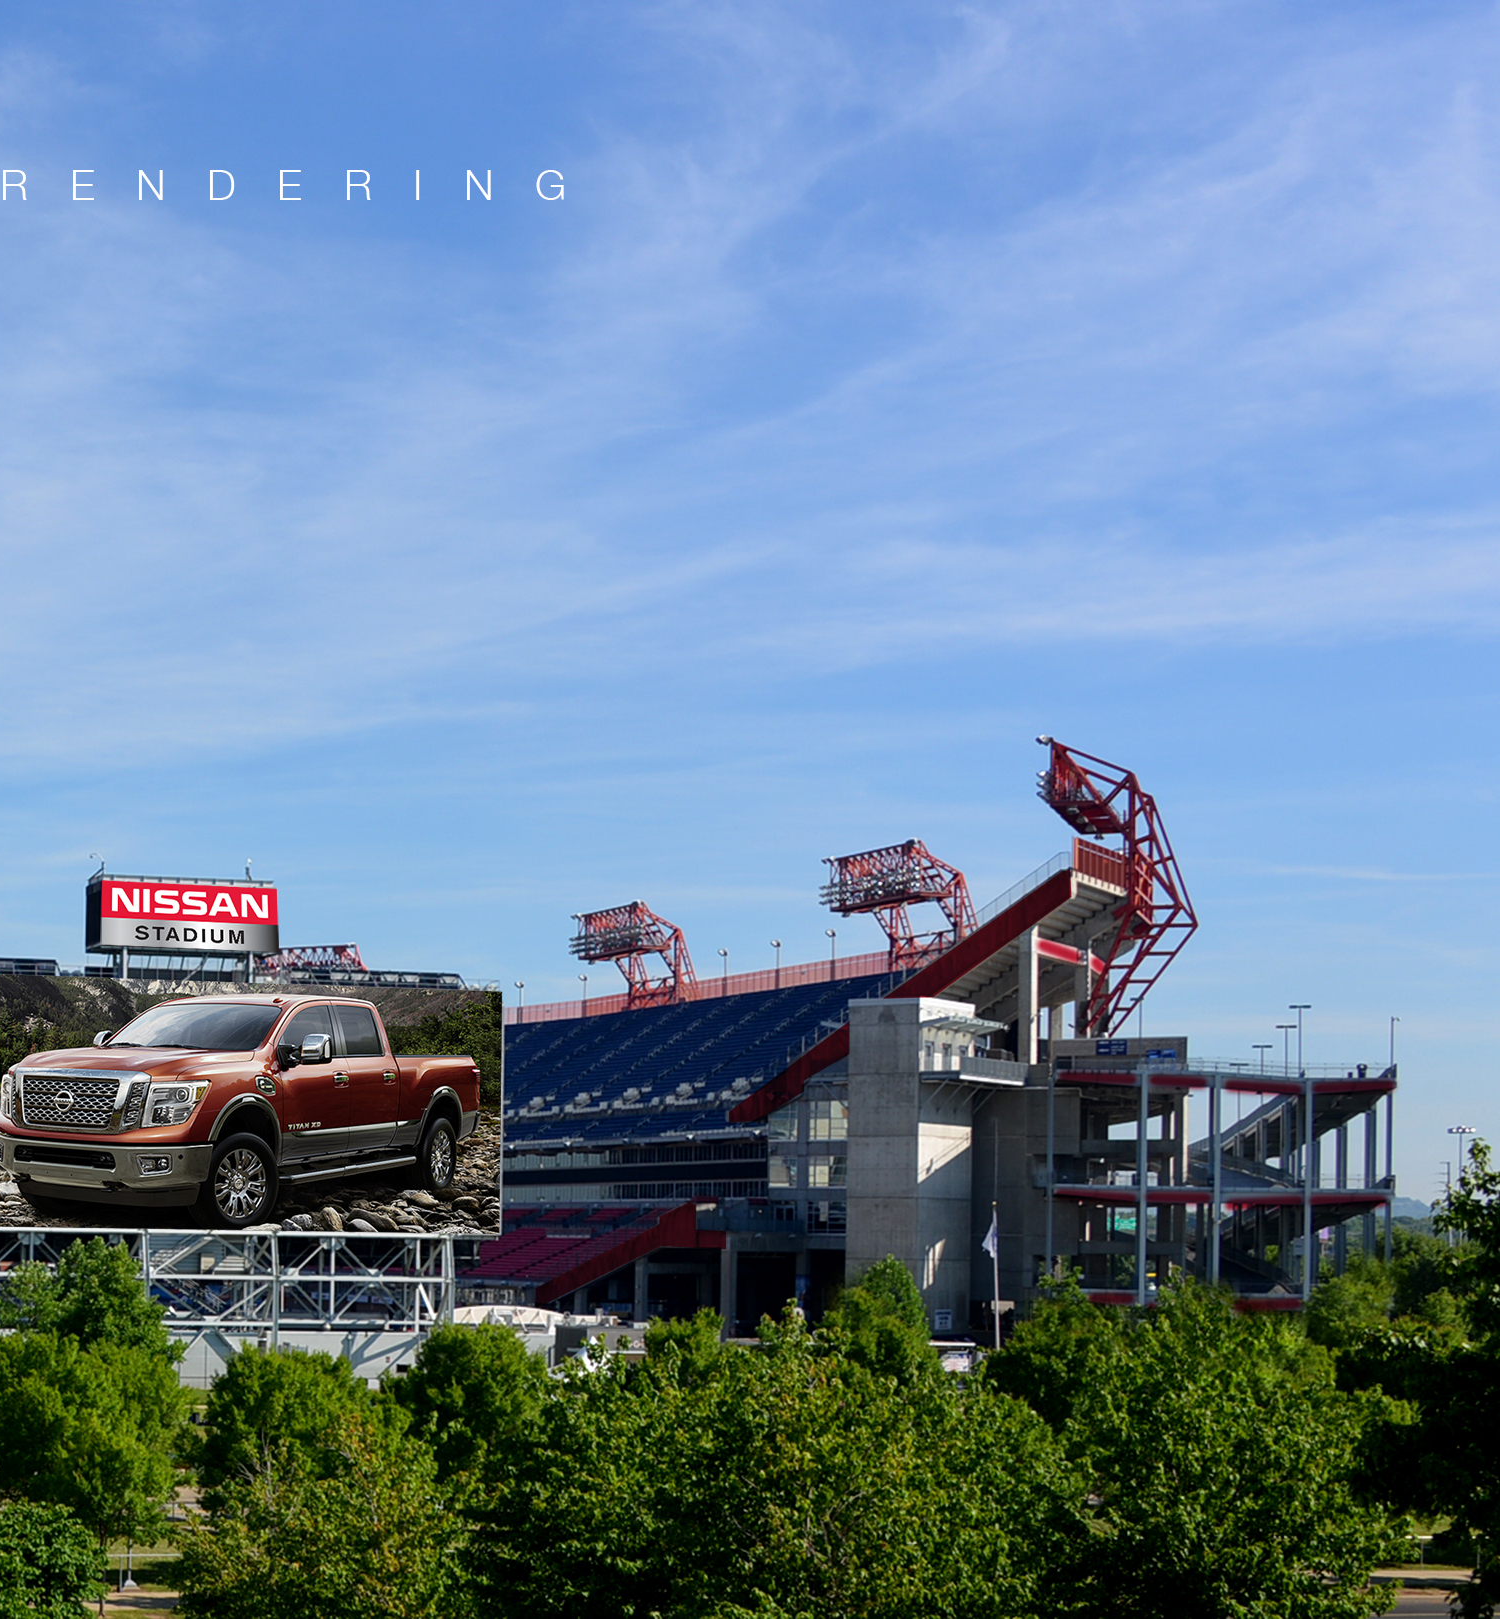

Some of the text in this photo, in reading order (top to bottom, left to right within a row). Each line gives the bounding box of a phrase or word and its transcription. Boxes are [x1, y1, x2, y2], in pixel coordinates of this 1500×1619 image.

[111, 887, 269, 919] NISSAN
[135, 925, 245, 945] STADIUM
[288, 1122, 310, 1130] TITAN
